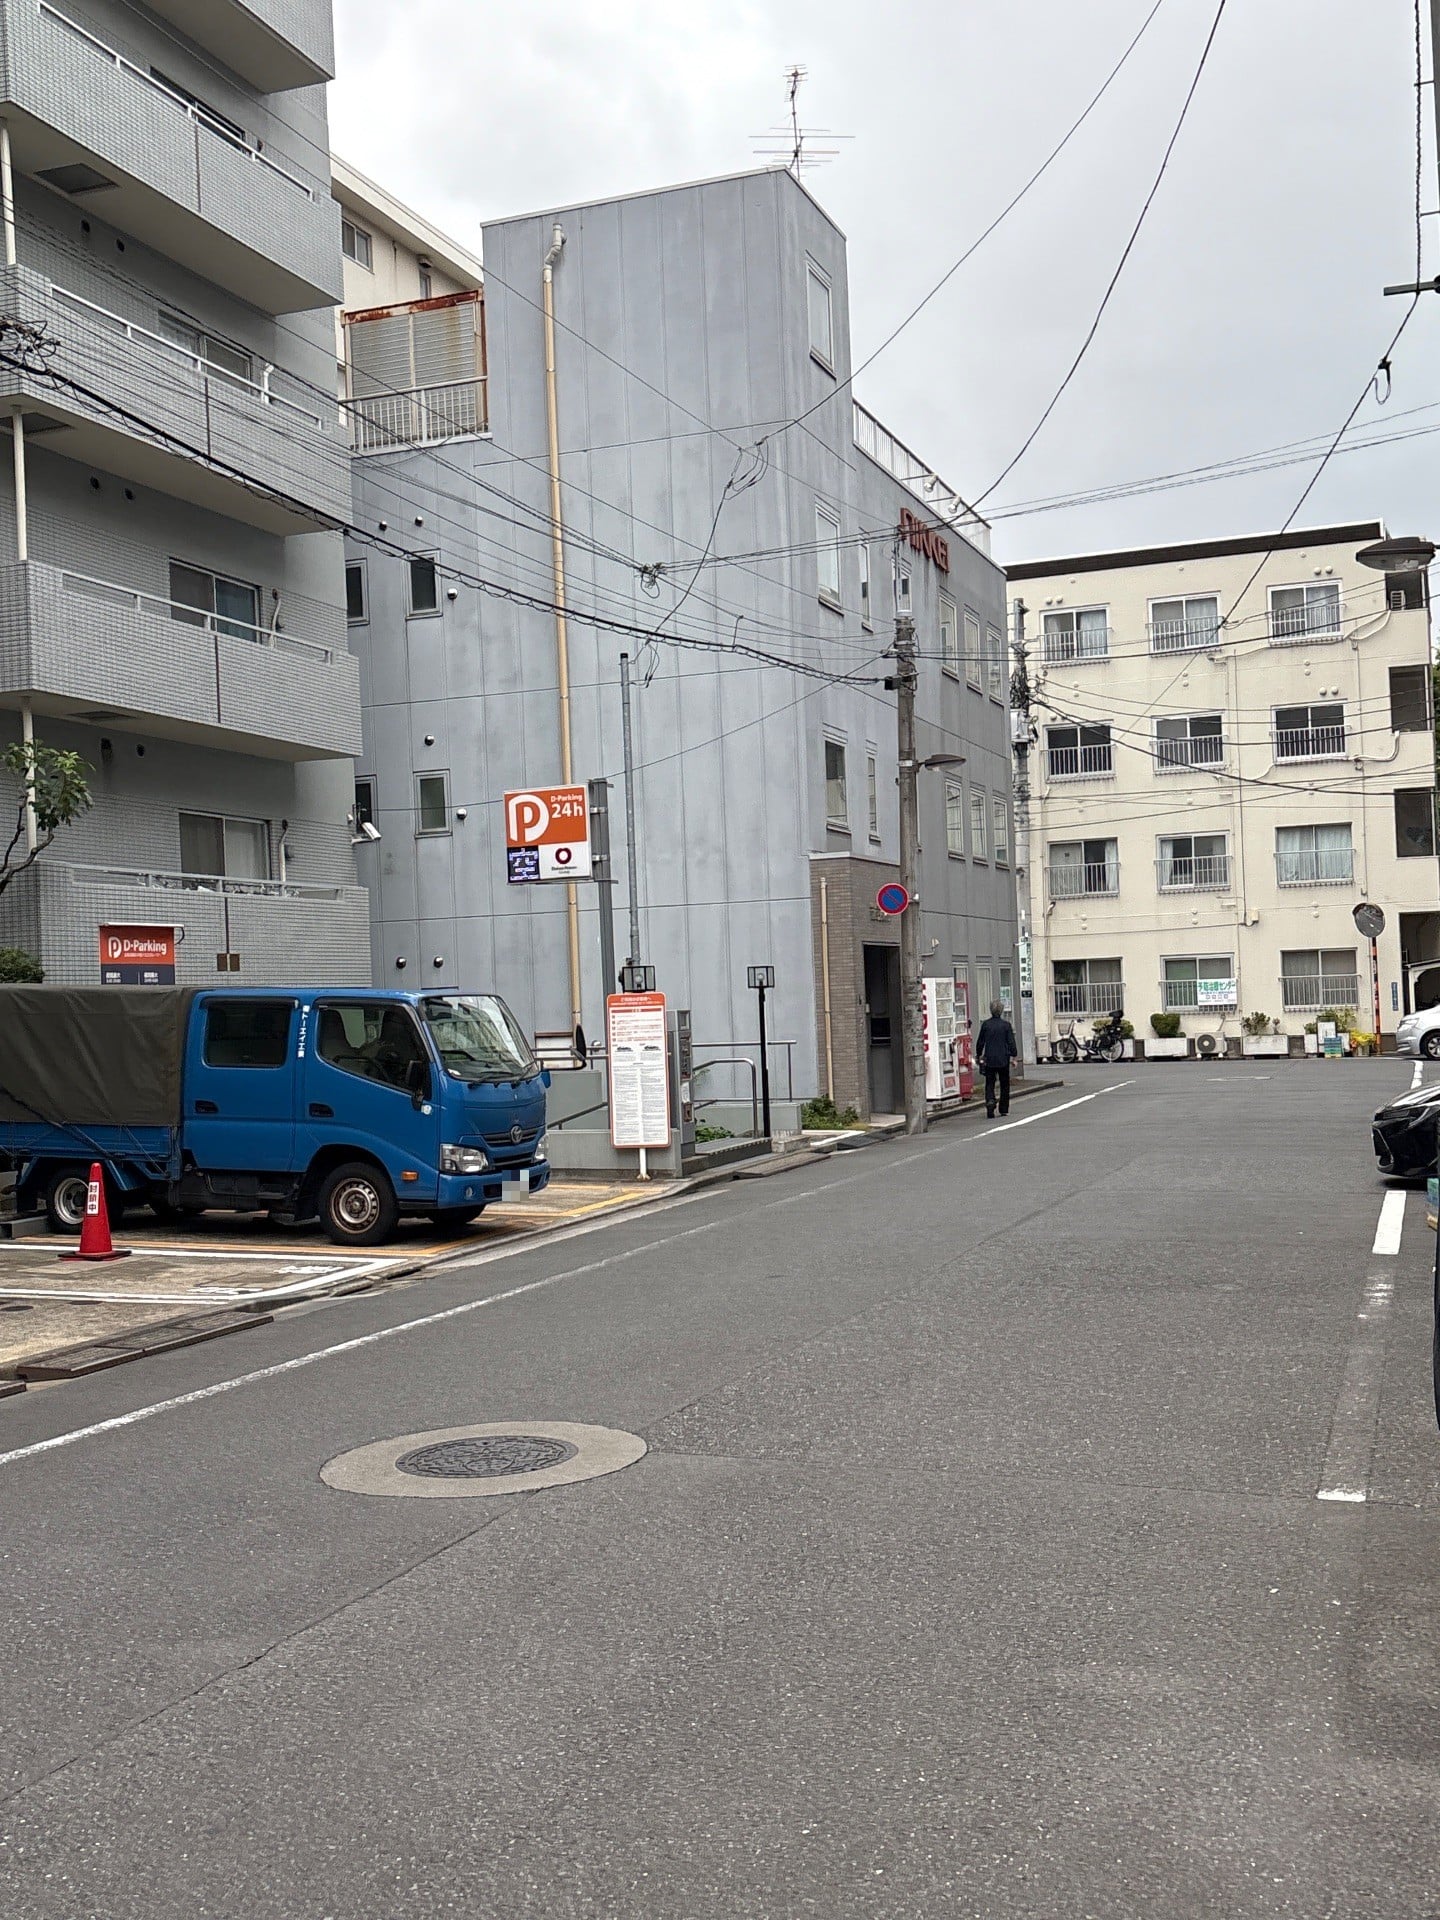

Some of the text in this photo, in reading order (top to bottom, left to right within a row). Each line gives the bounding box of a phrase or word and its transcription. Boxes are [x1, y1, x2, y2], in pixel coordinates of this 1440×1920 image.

[550, 793, 583, 802] D-Parking
[551, 802, 583, 818] 24h
[508, 847, 539, 880] 空
[123, 939, 167, 956] D-Parking
